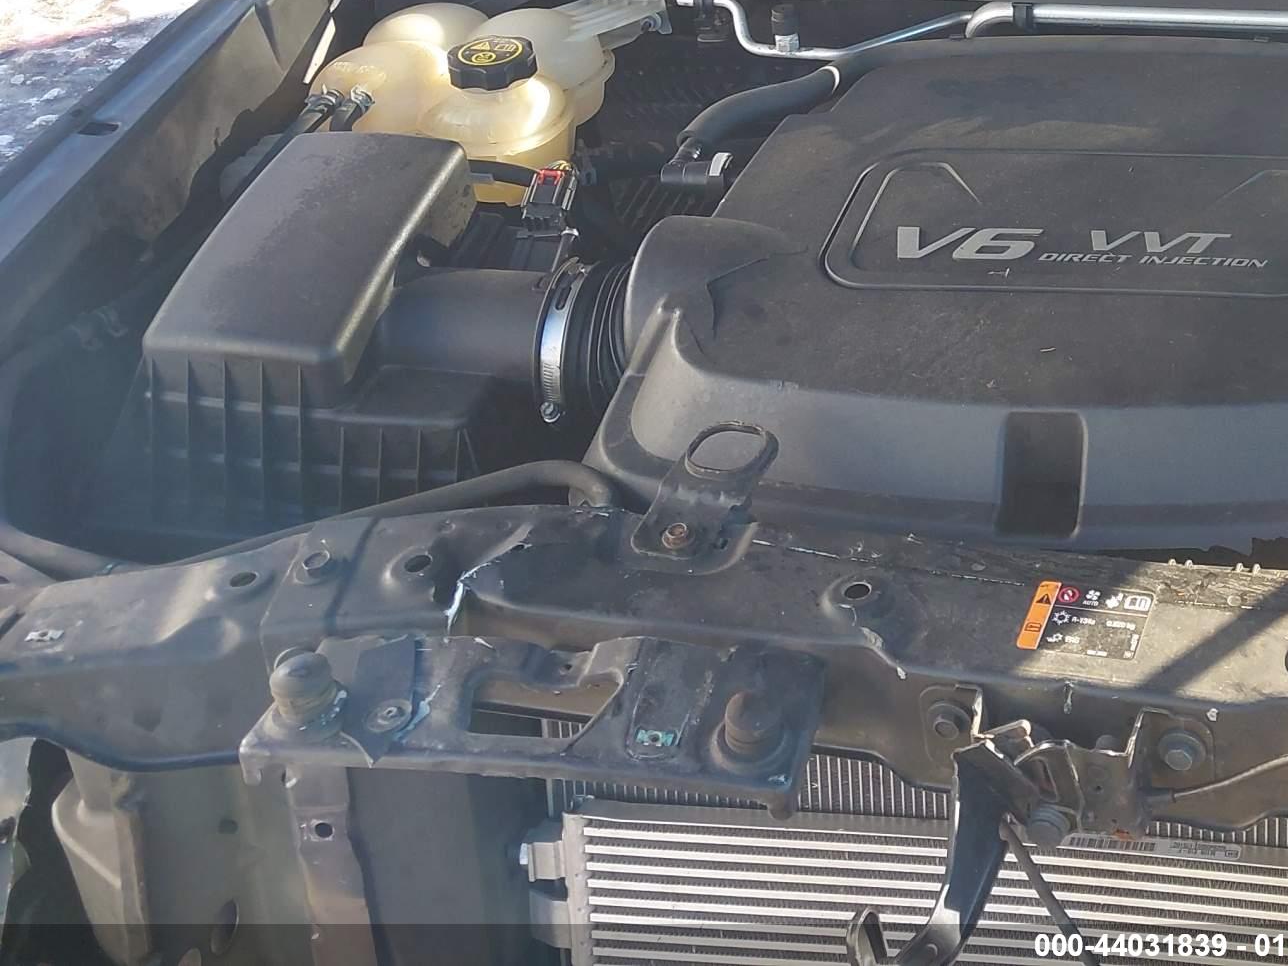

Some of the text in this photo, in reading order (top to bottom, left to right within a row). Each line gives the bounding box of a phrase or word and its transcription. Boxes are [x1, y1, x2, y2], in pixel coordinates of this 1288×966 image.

[897, 226, 1233, 260] V6 VVT
[1038, 252, 1269, 268] DIRECT INJECTION
